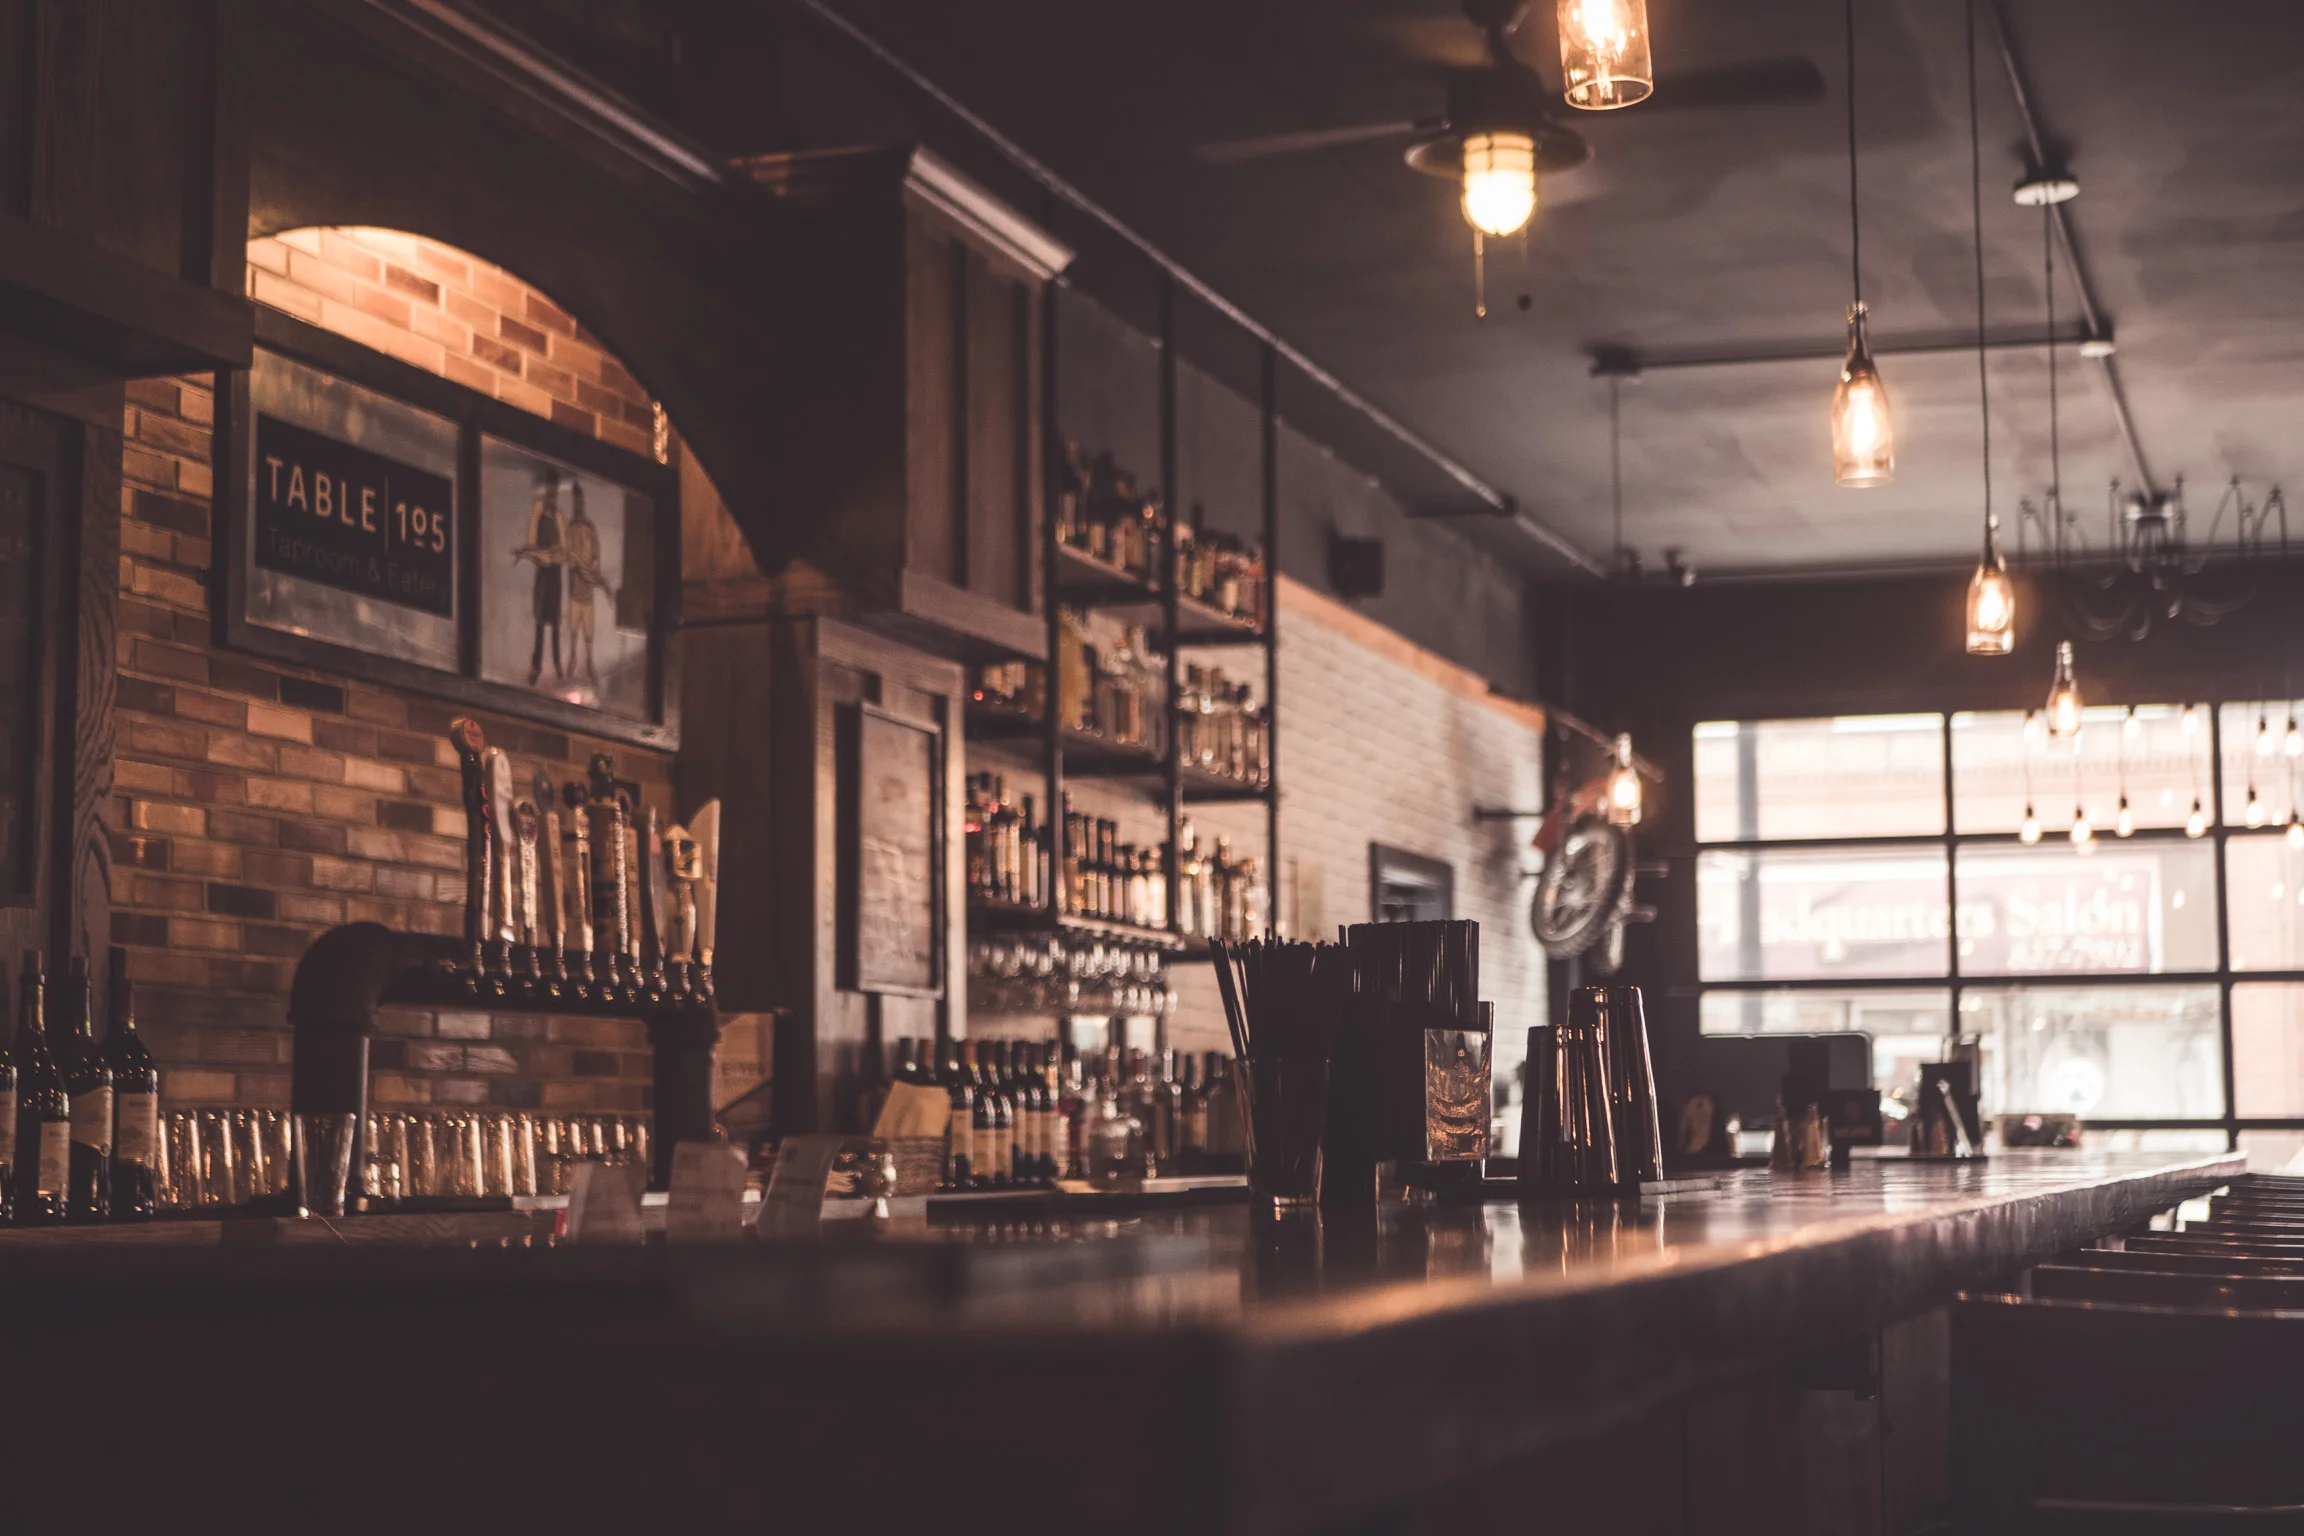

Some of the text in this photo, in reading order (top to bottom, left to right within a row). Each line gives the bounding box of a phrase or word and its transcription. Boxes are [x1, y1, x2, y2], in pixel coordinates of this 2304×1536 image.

[266, 455, 376, 533] TABLE
[268, 526, 447, 608] Taproom & Eatery
